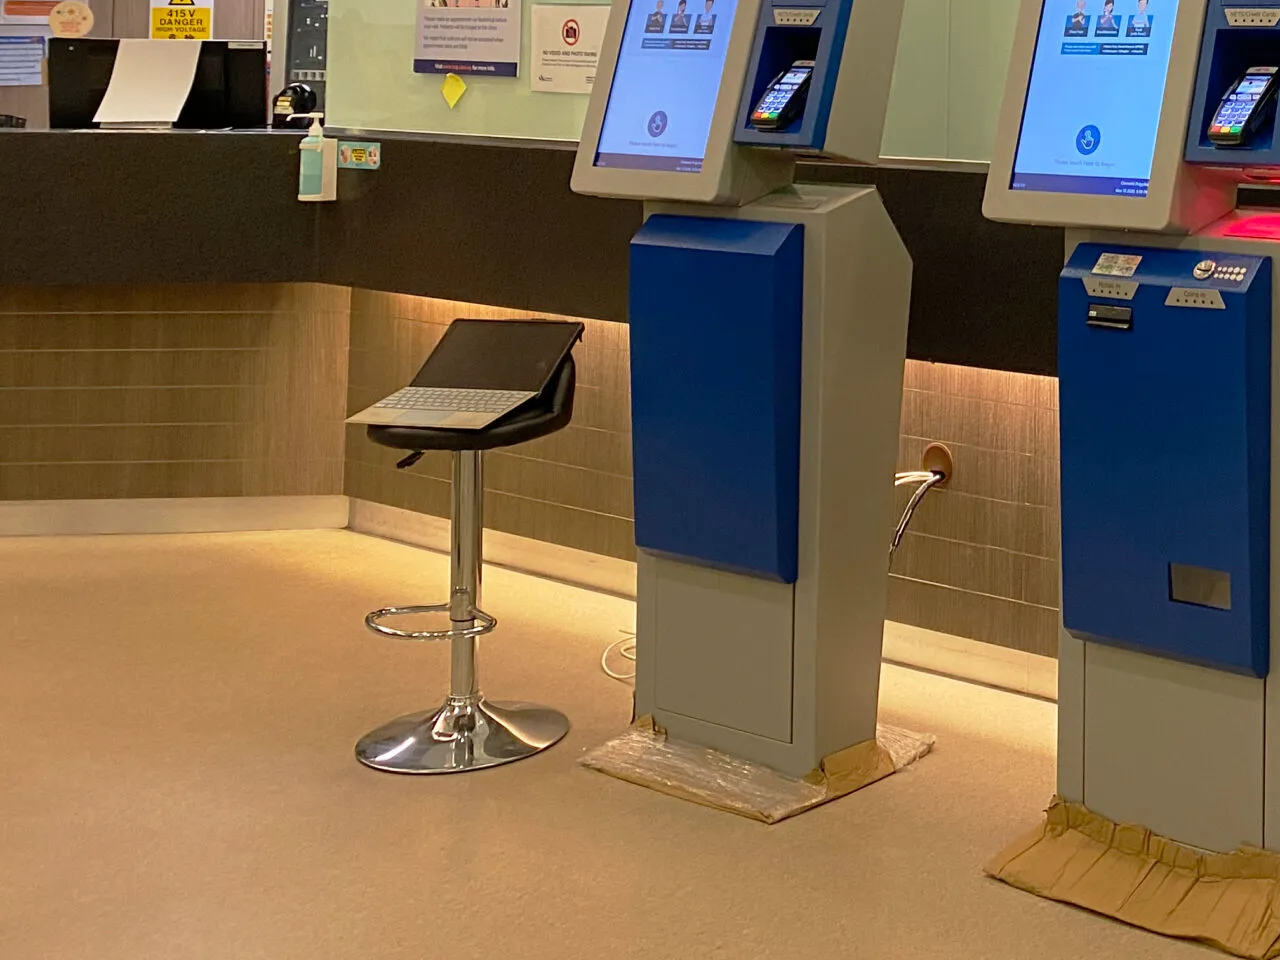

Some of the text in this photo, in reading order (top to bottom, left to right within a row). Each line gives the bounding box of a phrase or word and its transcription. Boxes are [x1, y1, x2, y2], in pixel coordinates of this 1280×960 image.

[167, 9, 196, 18] 415 V
[160, 18, 203, 26] DANGER
